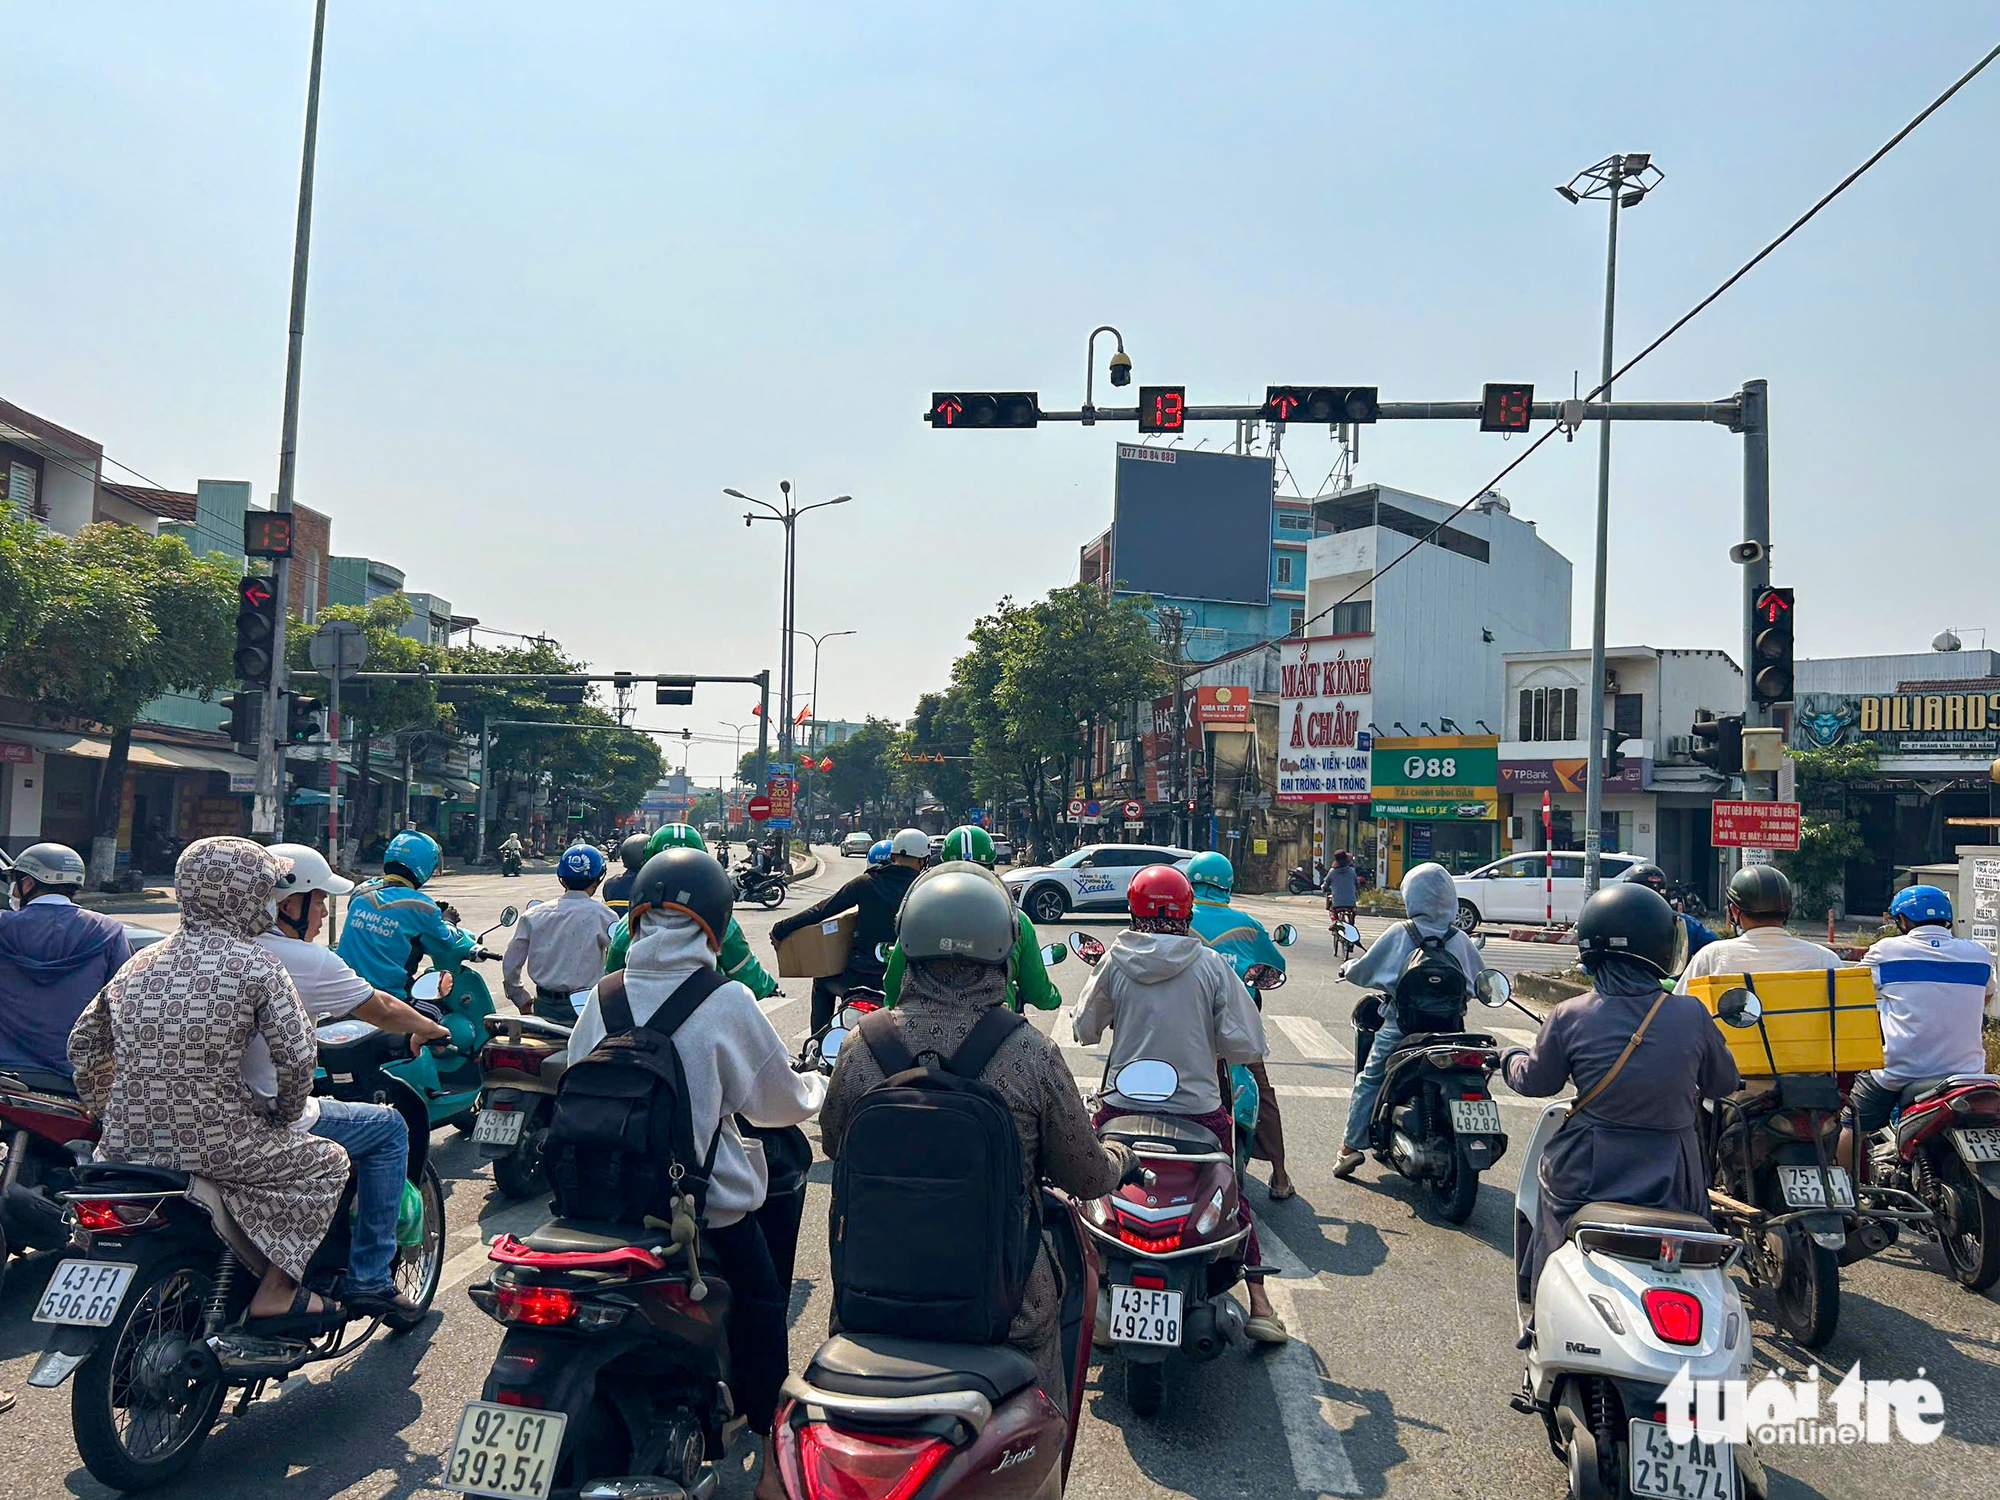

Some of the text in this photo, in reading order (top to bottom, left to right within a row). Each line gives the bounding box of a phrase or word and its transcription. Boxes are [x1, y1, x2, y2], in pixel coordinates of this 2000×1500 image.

[1155, 393, 1182, 428] 13
[1500, 391, 1528, 427] 13
[1121, 447, 1175, 462] 077 80 84 888
[263, 520, 290, 551] 13
[1281, 642, 1371, 699] MẮT KÍNH
[1289, 700, 1359, 748] Á CHÂU
[1860, 693, 2000, 732] BILLIARDS
[1281, 774, 1366, 791] HAI TRÒNG ĐA TRÒNG
[1514, 769, 1549, 779] TPBank
[1387, 805, 1408, 814] NHANH
[1439, 806, 1448, 814] XE
[1073, 879, 1116, 894] Xanh
[350, 917, 395, 938] xin chào!
[353, 908, 399, 929] XANH SM
[484, 1112, 516, 1127] 43-K1
[1458, 1102, 1490, 1116] 43-G1
[475, 1127, 517, 1142] 091.72
[1457, 1117, 1498, 1132] 482.82
[1789, 1169, 1836, 1186] 75-1
[62, 1265, 120, 1293] 43-F1
[43, 1292, 117, 1321] 596.66
[1121, 1289, 1169, 1316] 43-F1
[1113, 1314, 1177, 1343] 492.98
[471, 1410, 546, 1453] 92-G1
[1645, 1426, 1717, 1469] 43-AA
[451, 1448, 545, 1496] 393.54
[1636, 1459, 1728, 1500] 254.74
